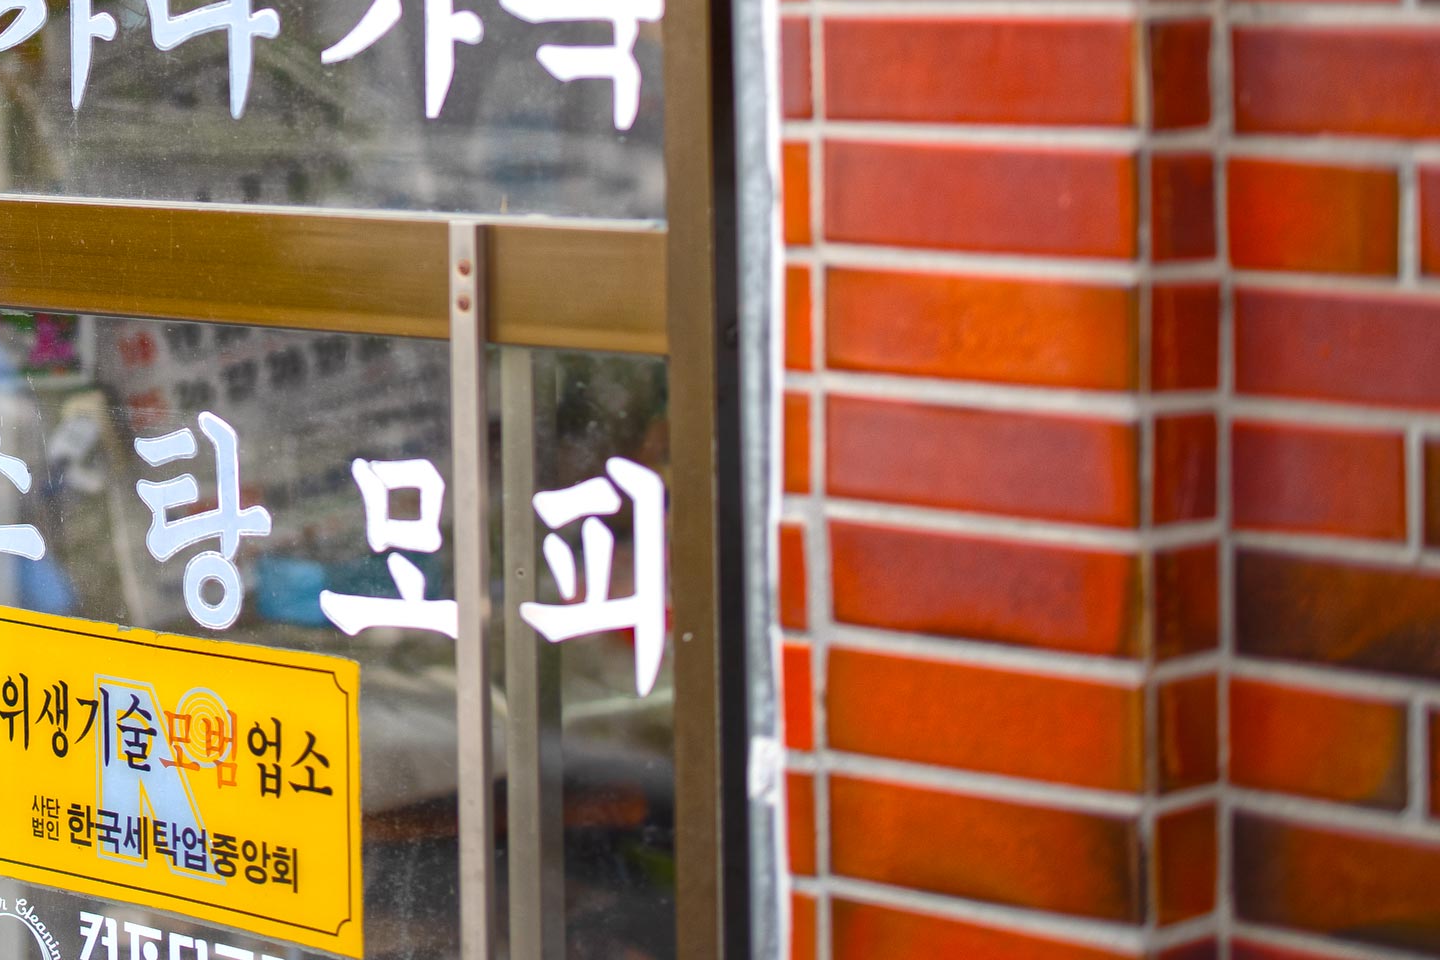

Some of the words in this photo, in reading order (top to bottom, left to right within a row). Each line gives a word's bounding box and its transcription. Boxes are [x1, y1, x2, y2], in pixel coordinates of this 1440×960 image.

[31, 794, 60, 819] 사단
[31, 818, 60, 841] 법인
[67, 802, 299, 893] 한국세탁업중앙회
